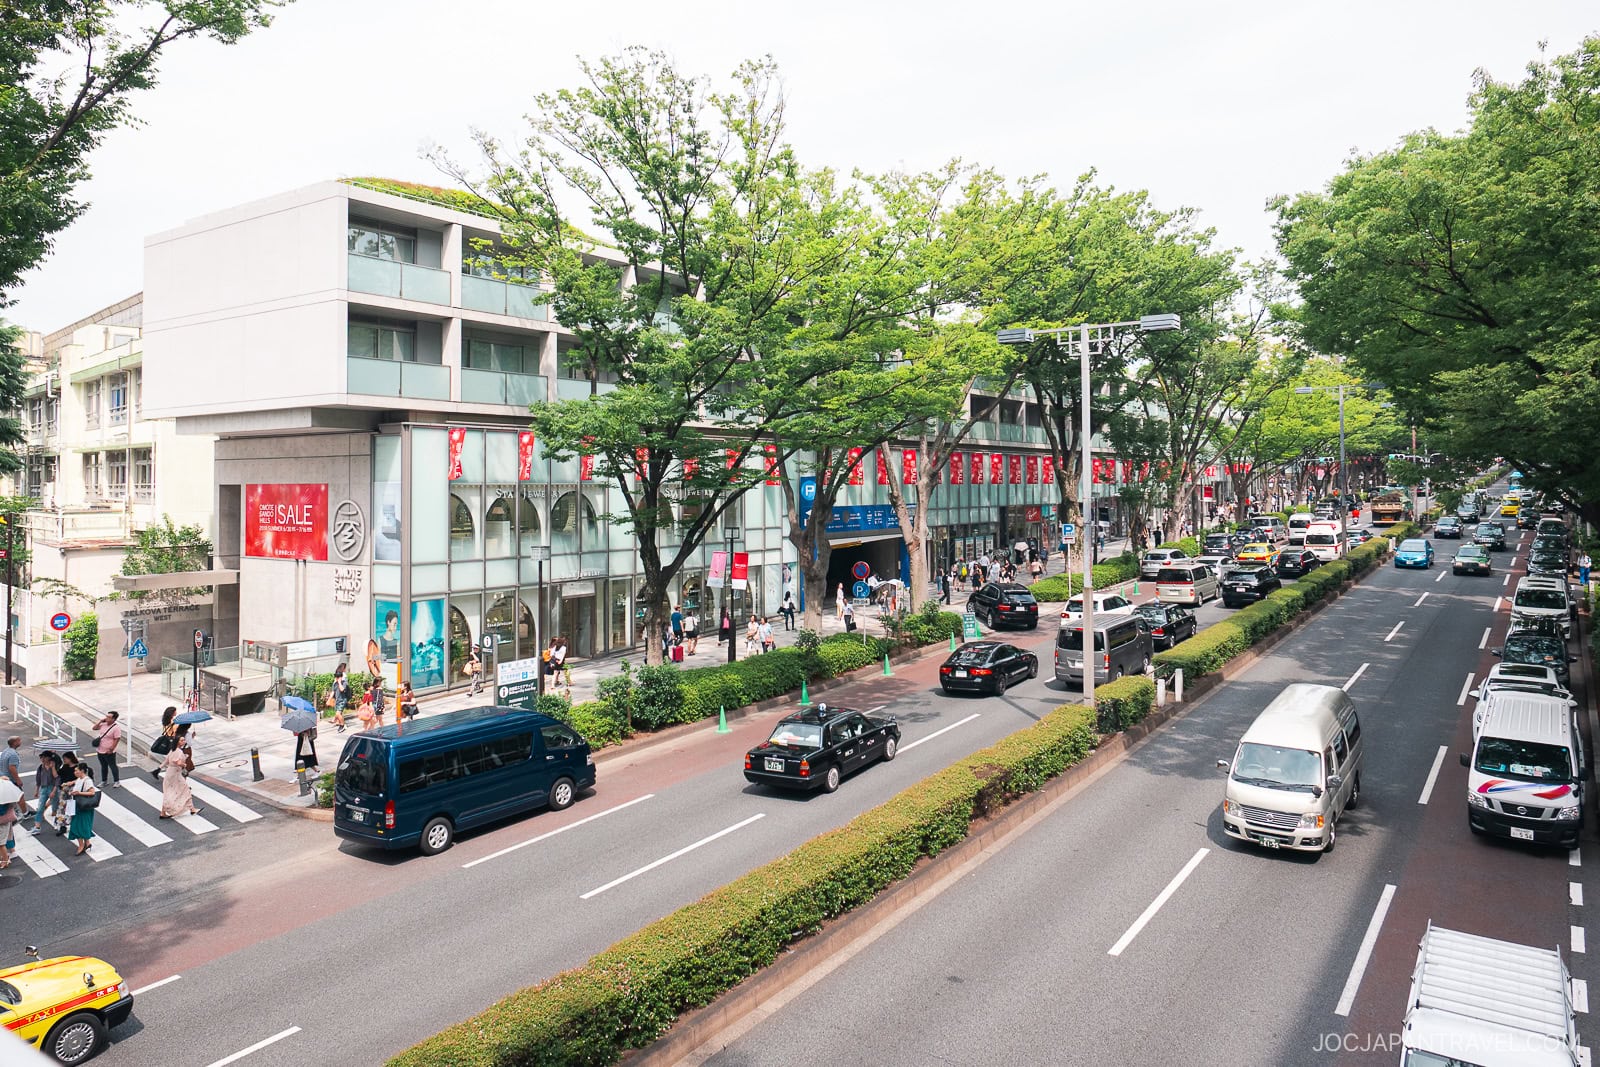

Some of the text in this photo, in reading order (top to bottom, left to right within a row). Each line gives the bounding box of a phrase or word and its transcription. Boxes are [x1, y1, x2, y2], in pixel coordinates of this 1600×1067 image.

[805, 485, 816, 496] P
[277, 504, 313, 525] SALE
[335, 568, 361, 579] OMOTE
[335, 579, 361, 592] SANDO
[124, 604, 200, 618] ZELKOVA TERRACE
[26, 1007, 57, 1023] TAXI
